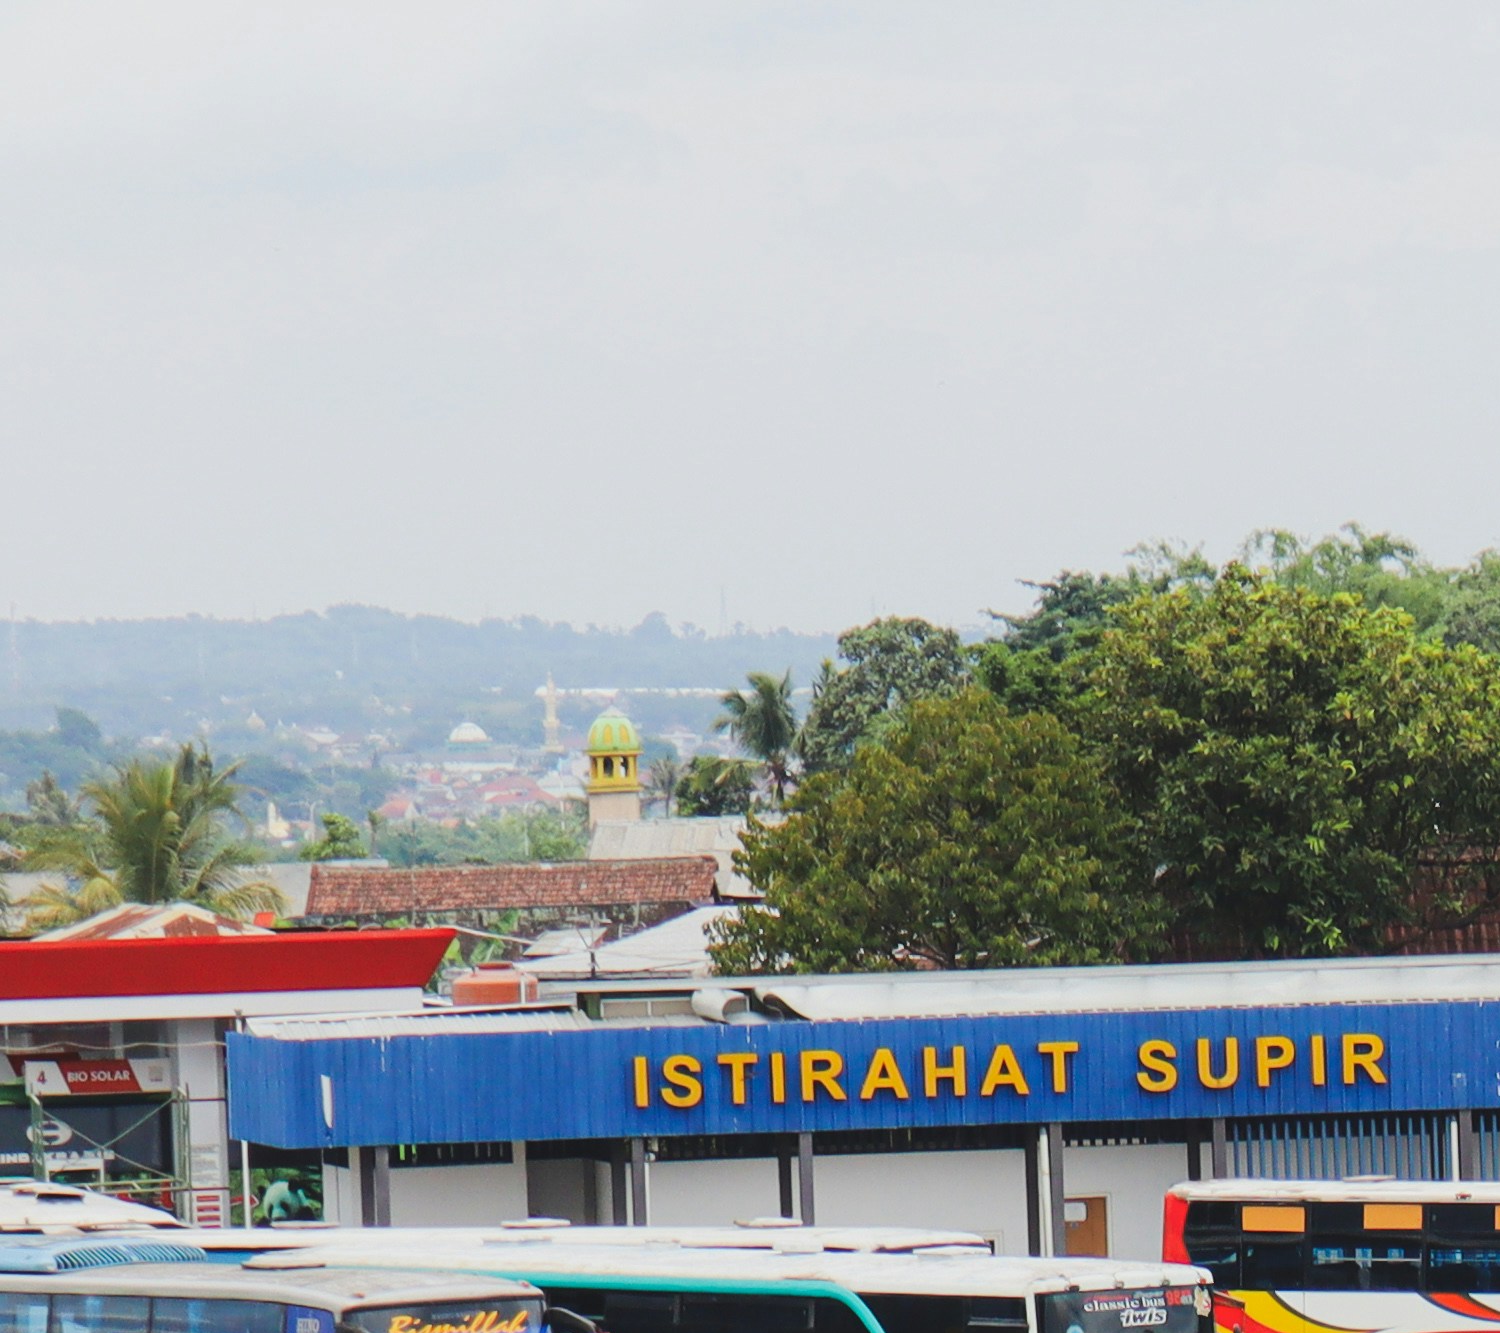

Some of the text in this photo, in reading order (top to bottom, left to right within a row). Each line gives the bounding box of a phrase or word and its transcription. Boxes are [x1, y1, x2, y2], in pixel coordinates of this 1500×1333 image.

[37, 1070, 47, 1084] 4
[67, 1070, 130, 1083] BIO SOLAR
[633, 1033, 1388, 1107] ISTIRAHAT SUPIR
[1083, 1297, 1140, 1313] classic
